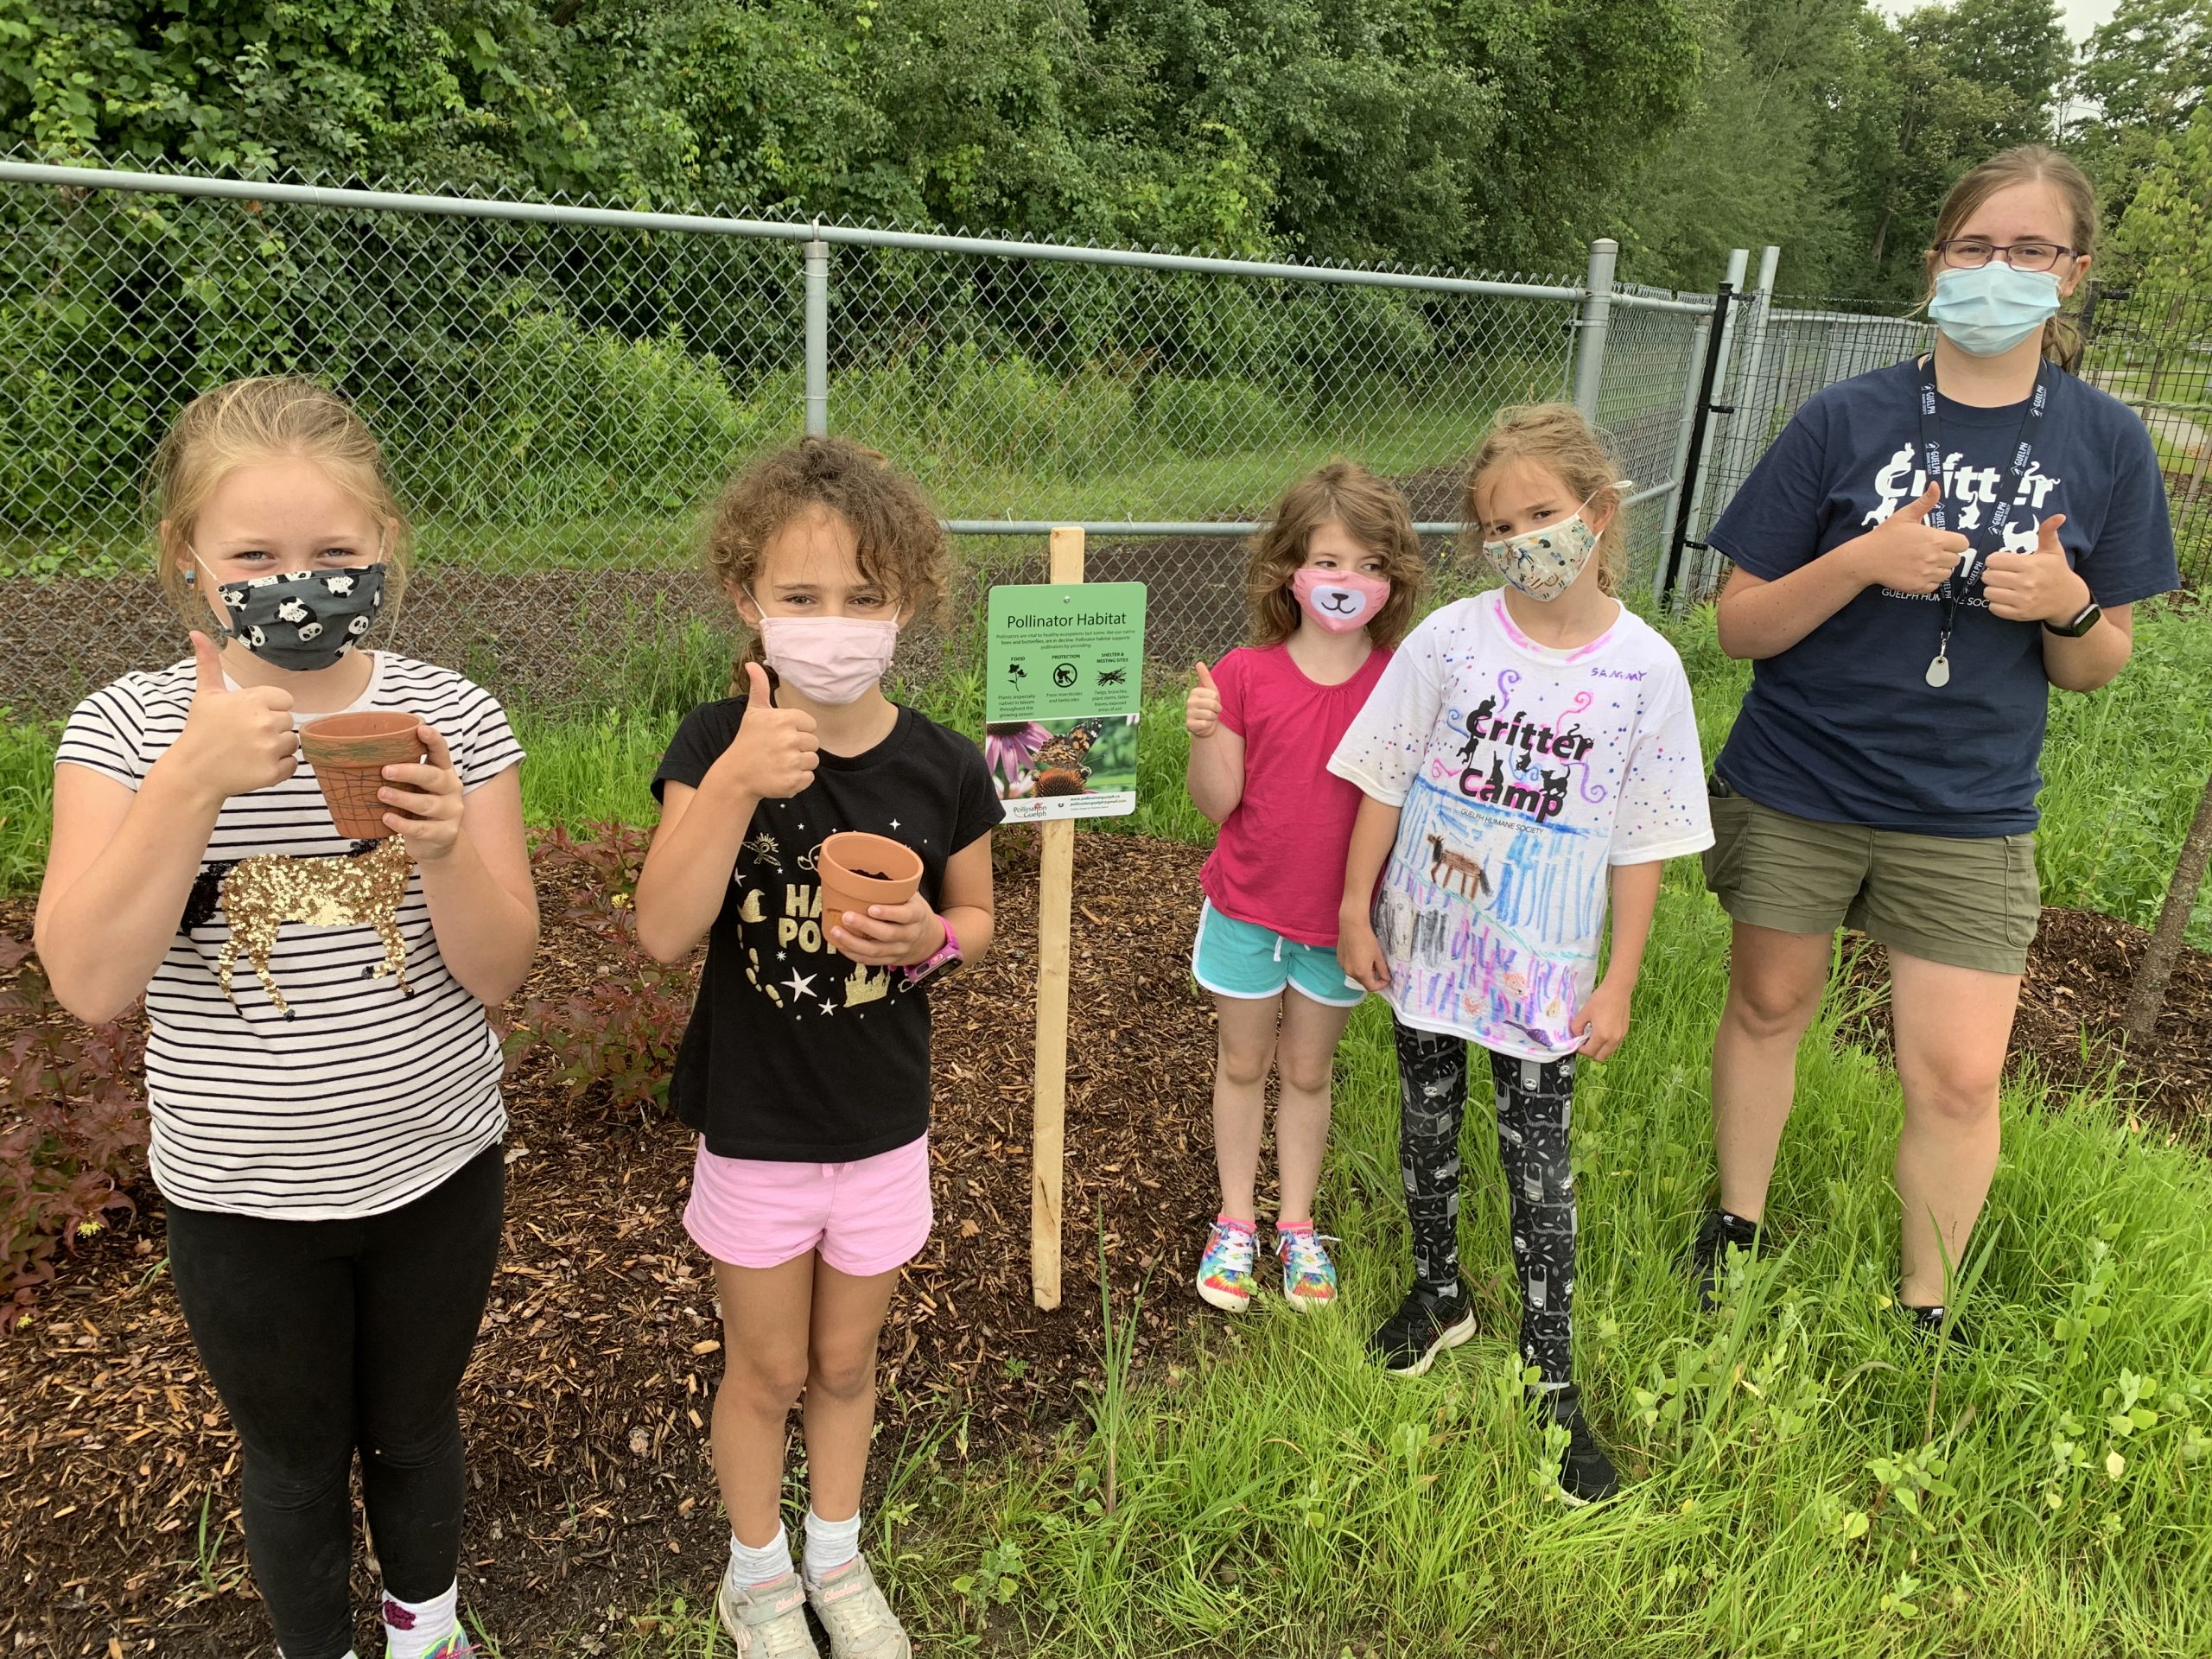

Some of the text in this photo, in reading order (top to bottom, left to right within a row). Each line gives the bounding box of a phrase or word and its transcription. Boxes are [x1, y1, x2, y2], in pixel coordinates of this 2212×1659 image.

[1926, 392, 1936, 415] GUELPH
[2033, 385, 2044, 407] GUELPH
[1931, 451, 1941, 475] GUELPH
[2014, 442, 2028, 466] GUELPH
[1936, 512, 1945, 531] GUELP
[1992, 501, 2007, 525] GUELPH
[1967, 561, 1983, 585] GUELPH
[1007, 612, 1127, 629] Pollinator Habitat
[1466, 707, 1594, 760] Critter
[1461, 808, 1545, 834] GUELPH HUMANE SOCIETY
[786, 884, 822, 918] HA
[779, 918, 837, 954] PO
